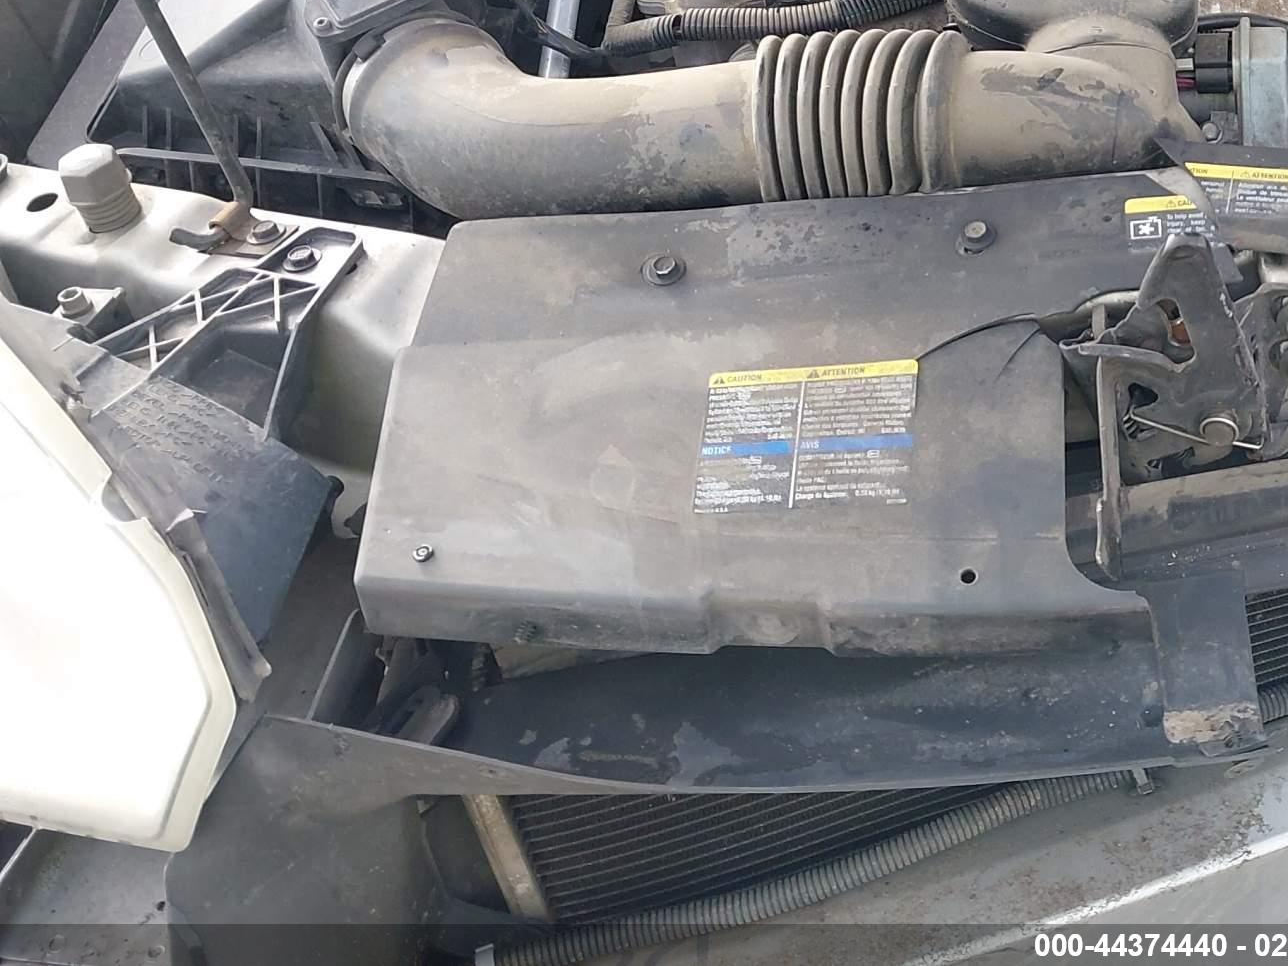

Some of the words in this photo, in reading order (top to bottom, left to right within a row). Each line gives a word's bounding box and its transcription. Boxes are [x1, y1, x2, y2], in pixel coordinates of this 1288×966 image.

[820, 366, 866, 377] ATTENTION
[726, 374, 763, 383] CAUTION
[800, 440, 820, 449] AVIS
[701, 445, 732, 456] NOTICE
